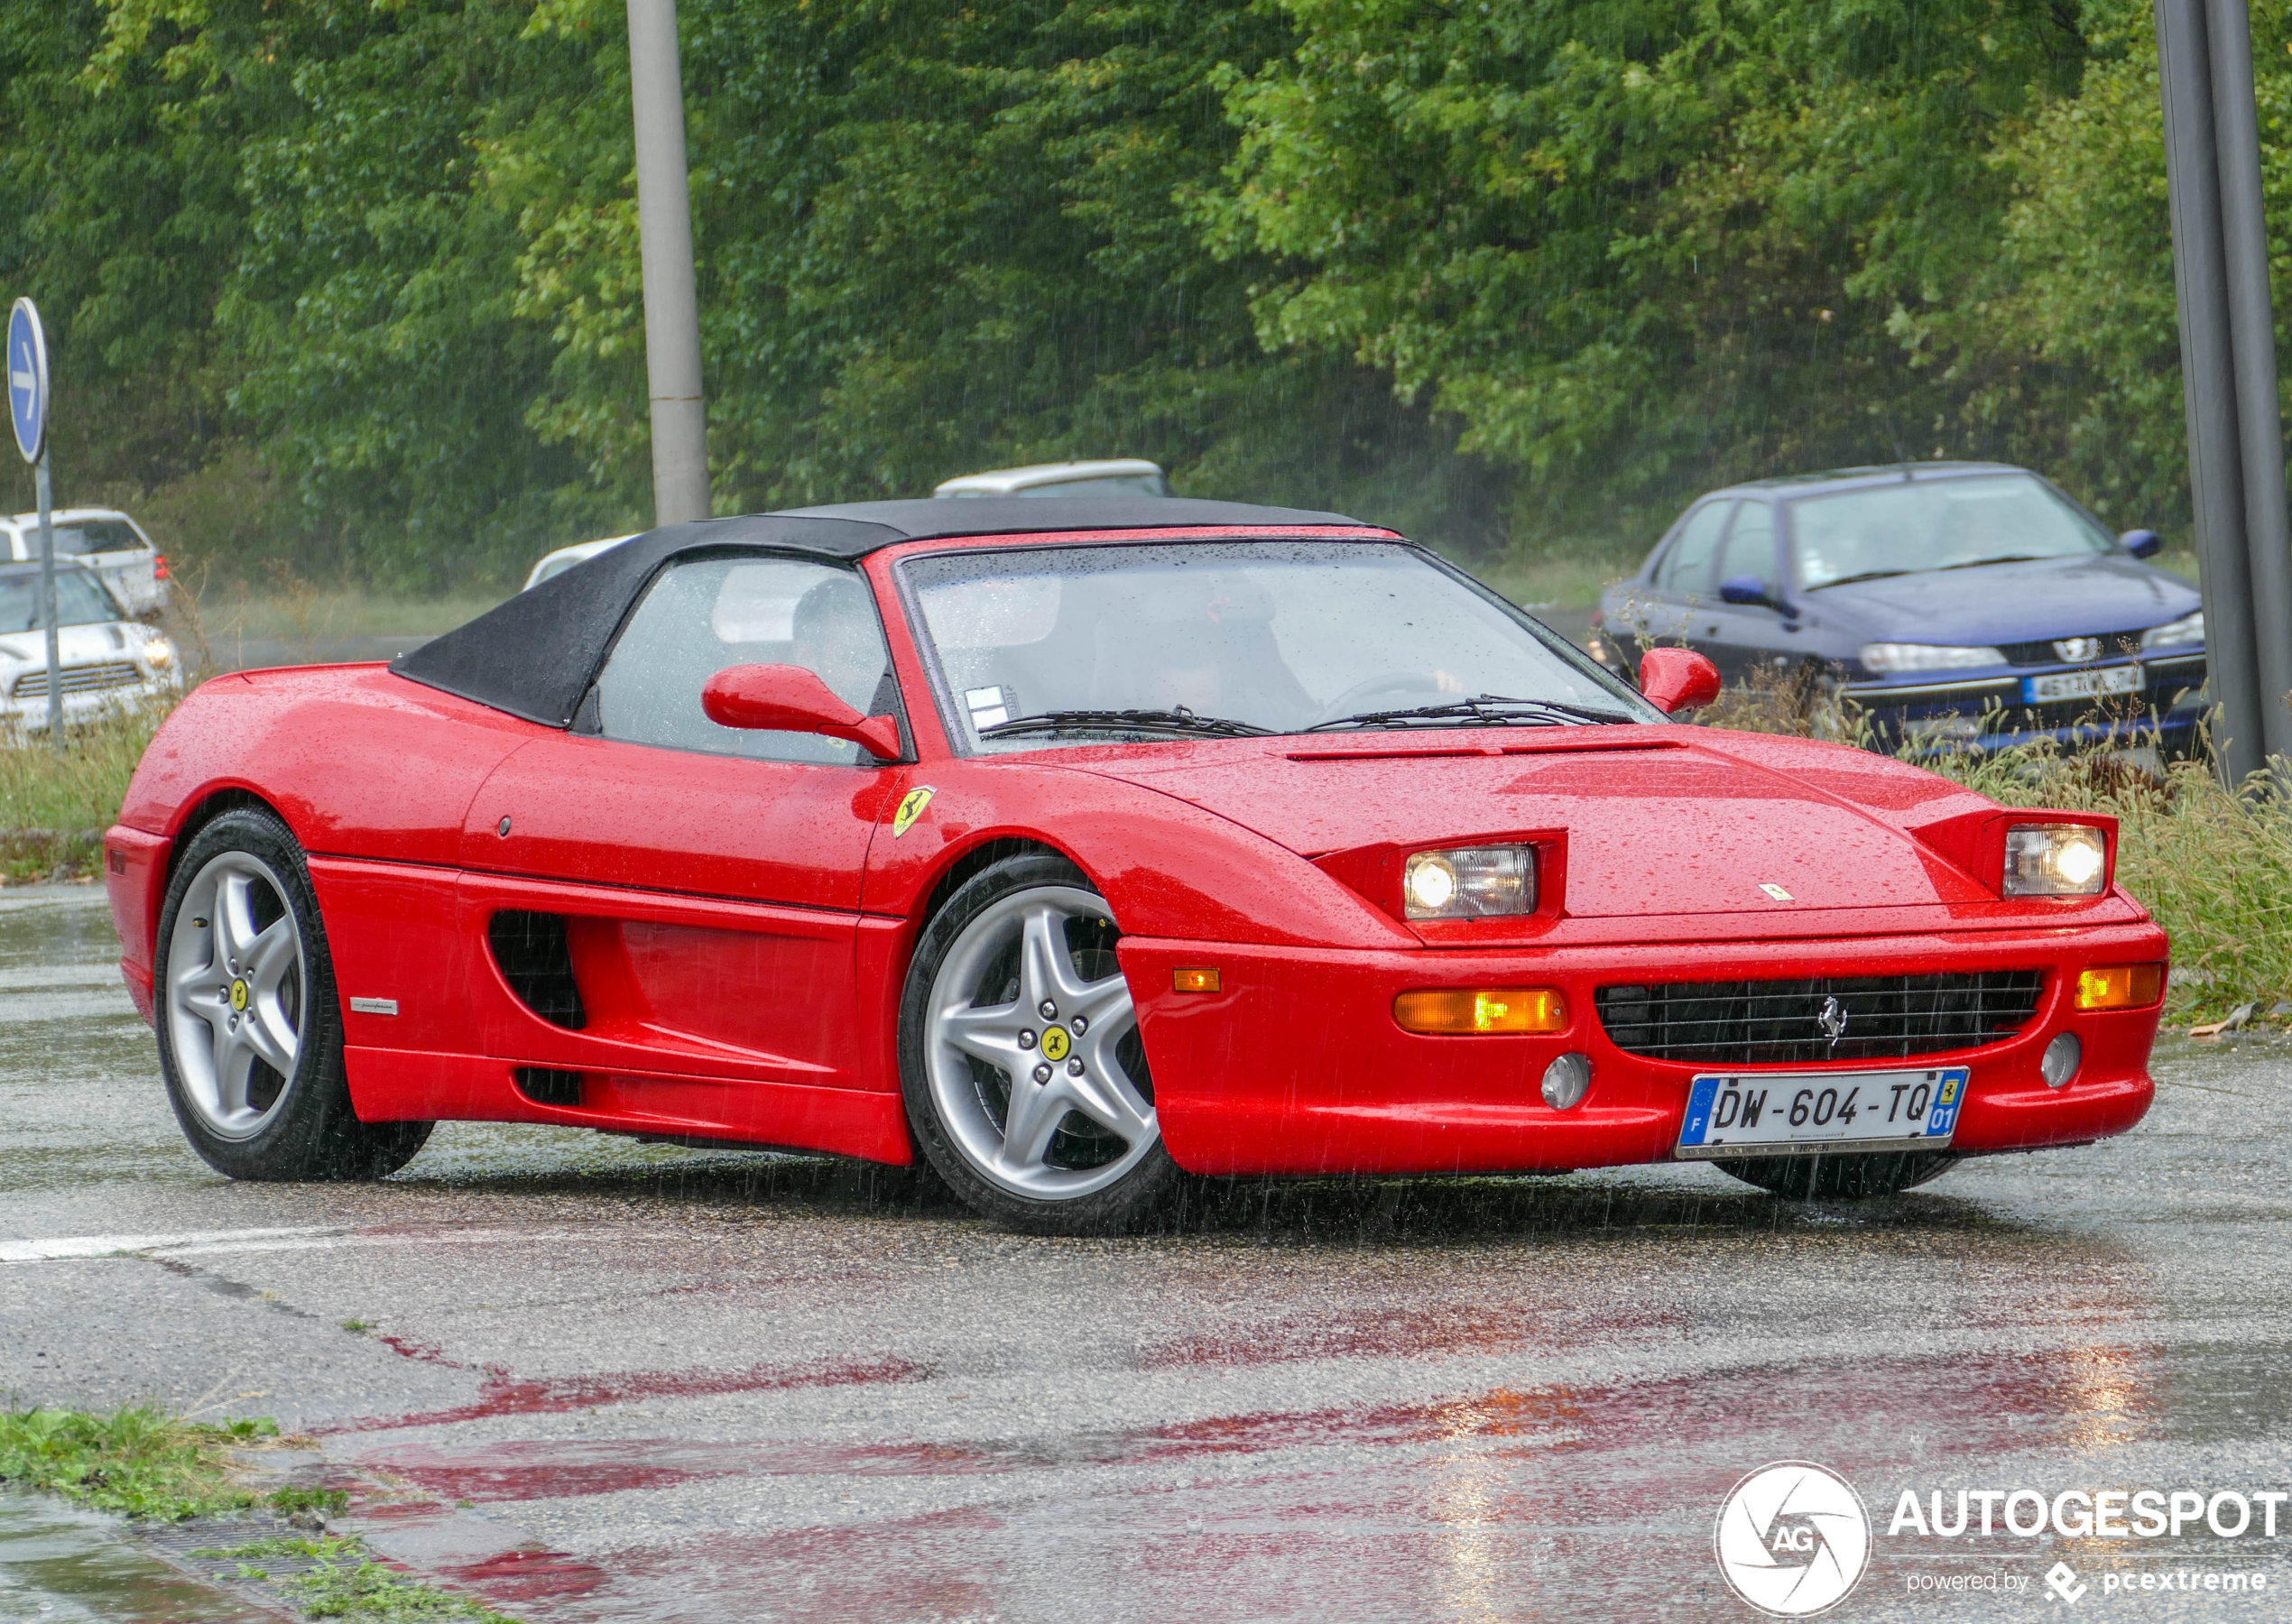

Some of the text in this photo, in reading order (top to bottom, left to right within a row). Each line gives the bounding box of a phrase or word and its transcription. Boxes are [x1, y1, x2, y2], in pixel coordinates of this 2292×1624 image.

[1005, 691, 1022, 718] Ferrar
[1714, 1084, 1931, 1129] DW-604-TQ
[1690, 1117, 1702, 1131] F
[1931, 1108, 1955, 1130] 01
[1798, 1142, 1830, 1152] Ferrari
